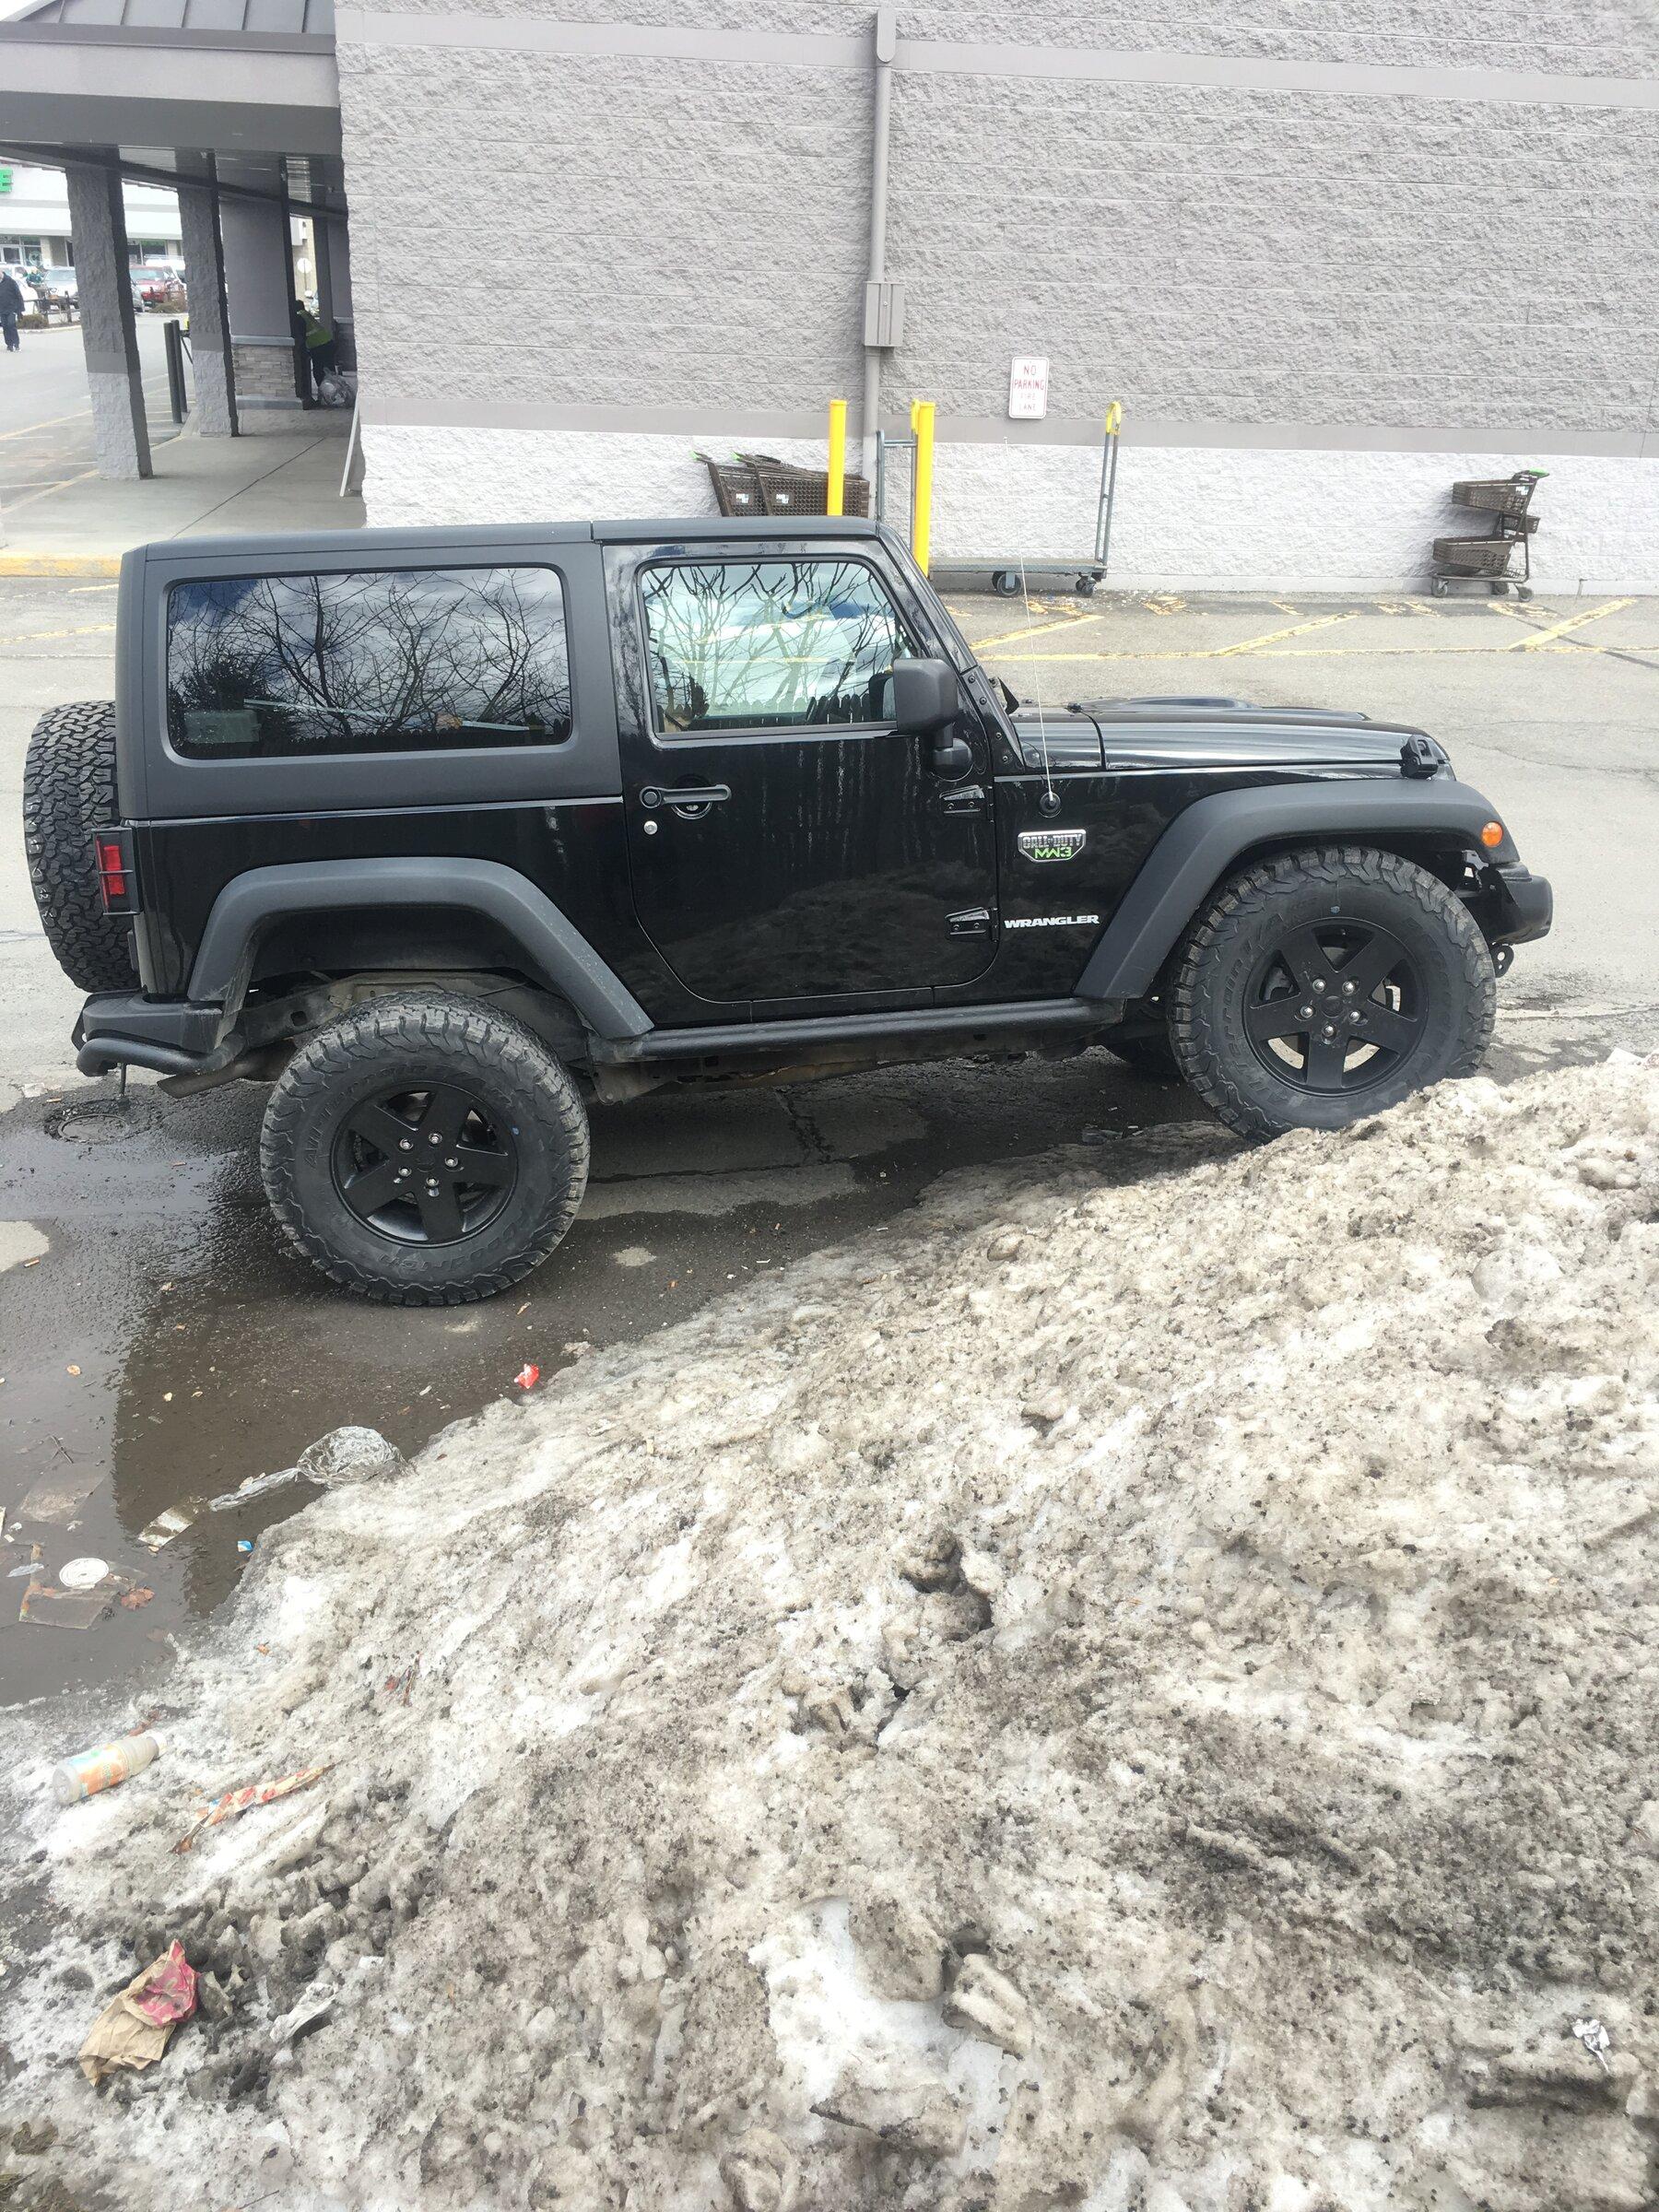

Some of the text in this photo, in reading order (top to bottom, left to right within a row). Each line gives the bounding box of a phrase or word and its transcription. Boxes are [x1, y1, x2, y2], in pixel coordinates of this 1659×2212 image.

[1023, 364, 1037, 376] NO
[1014, 379, 1045, 391] PARKING
[1023, 835, 1049, 849] CALL
[1053, 833, 1082, 847] DUTY
[1034, 846, 1072, 859] MW3
[1005, 915, 1100, 929] WRANGLER
